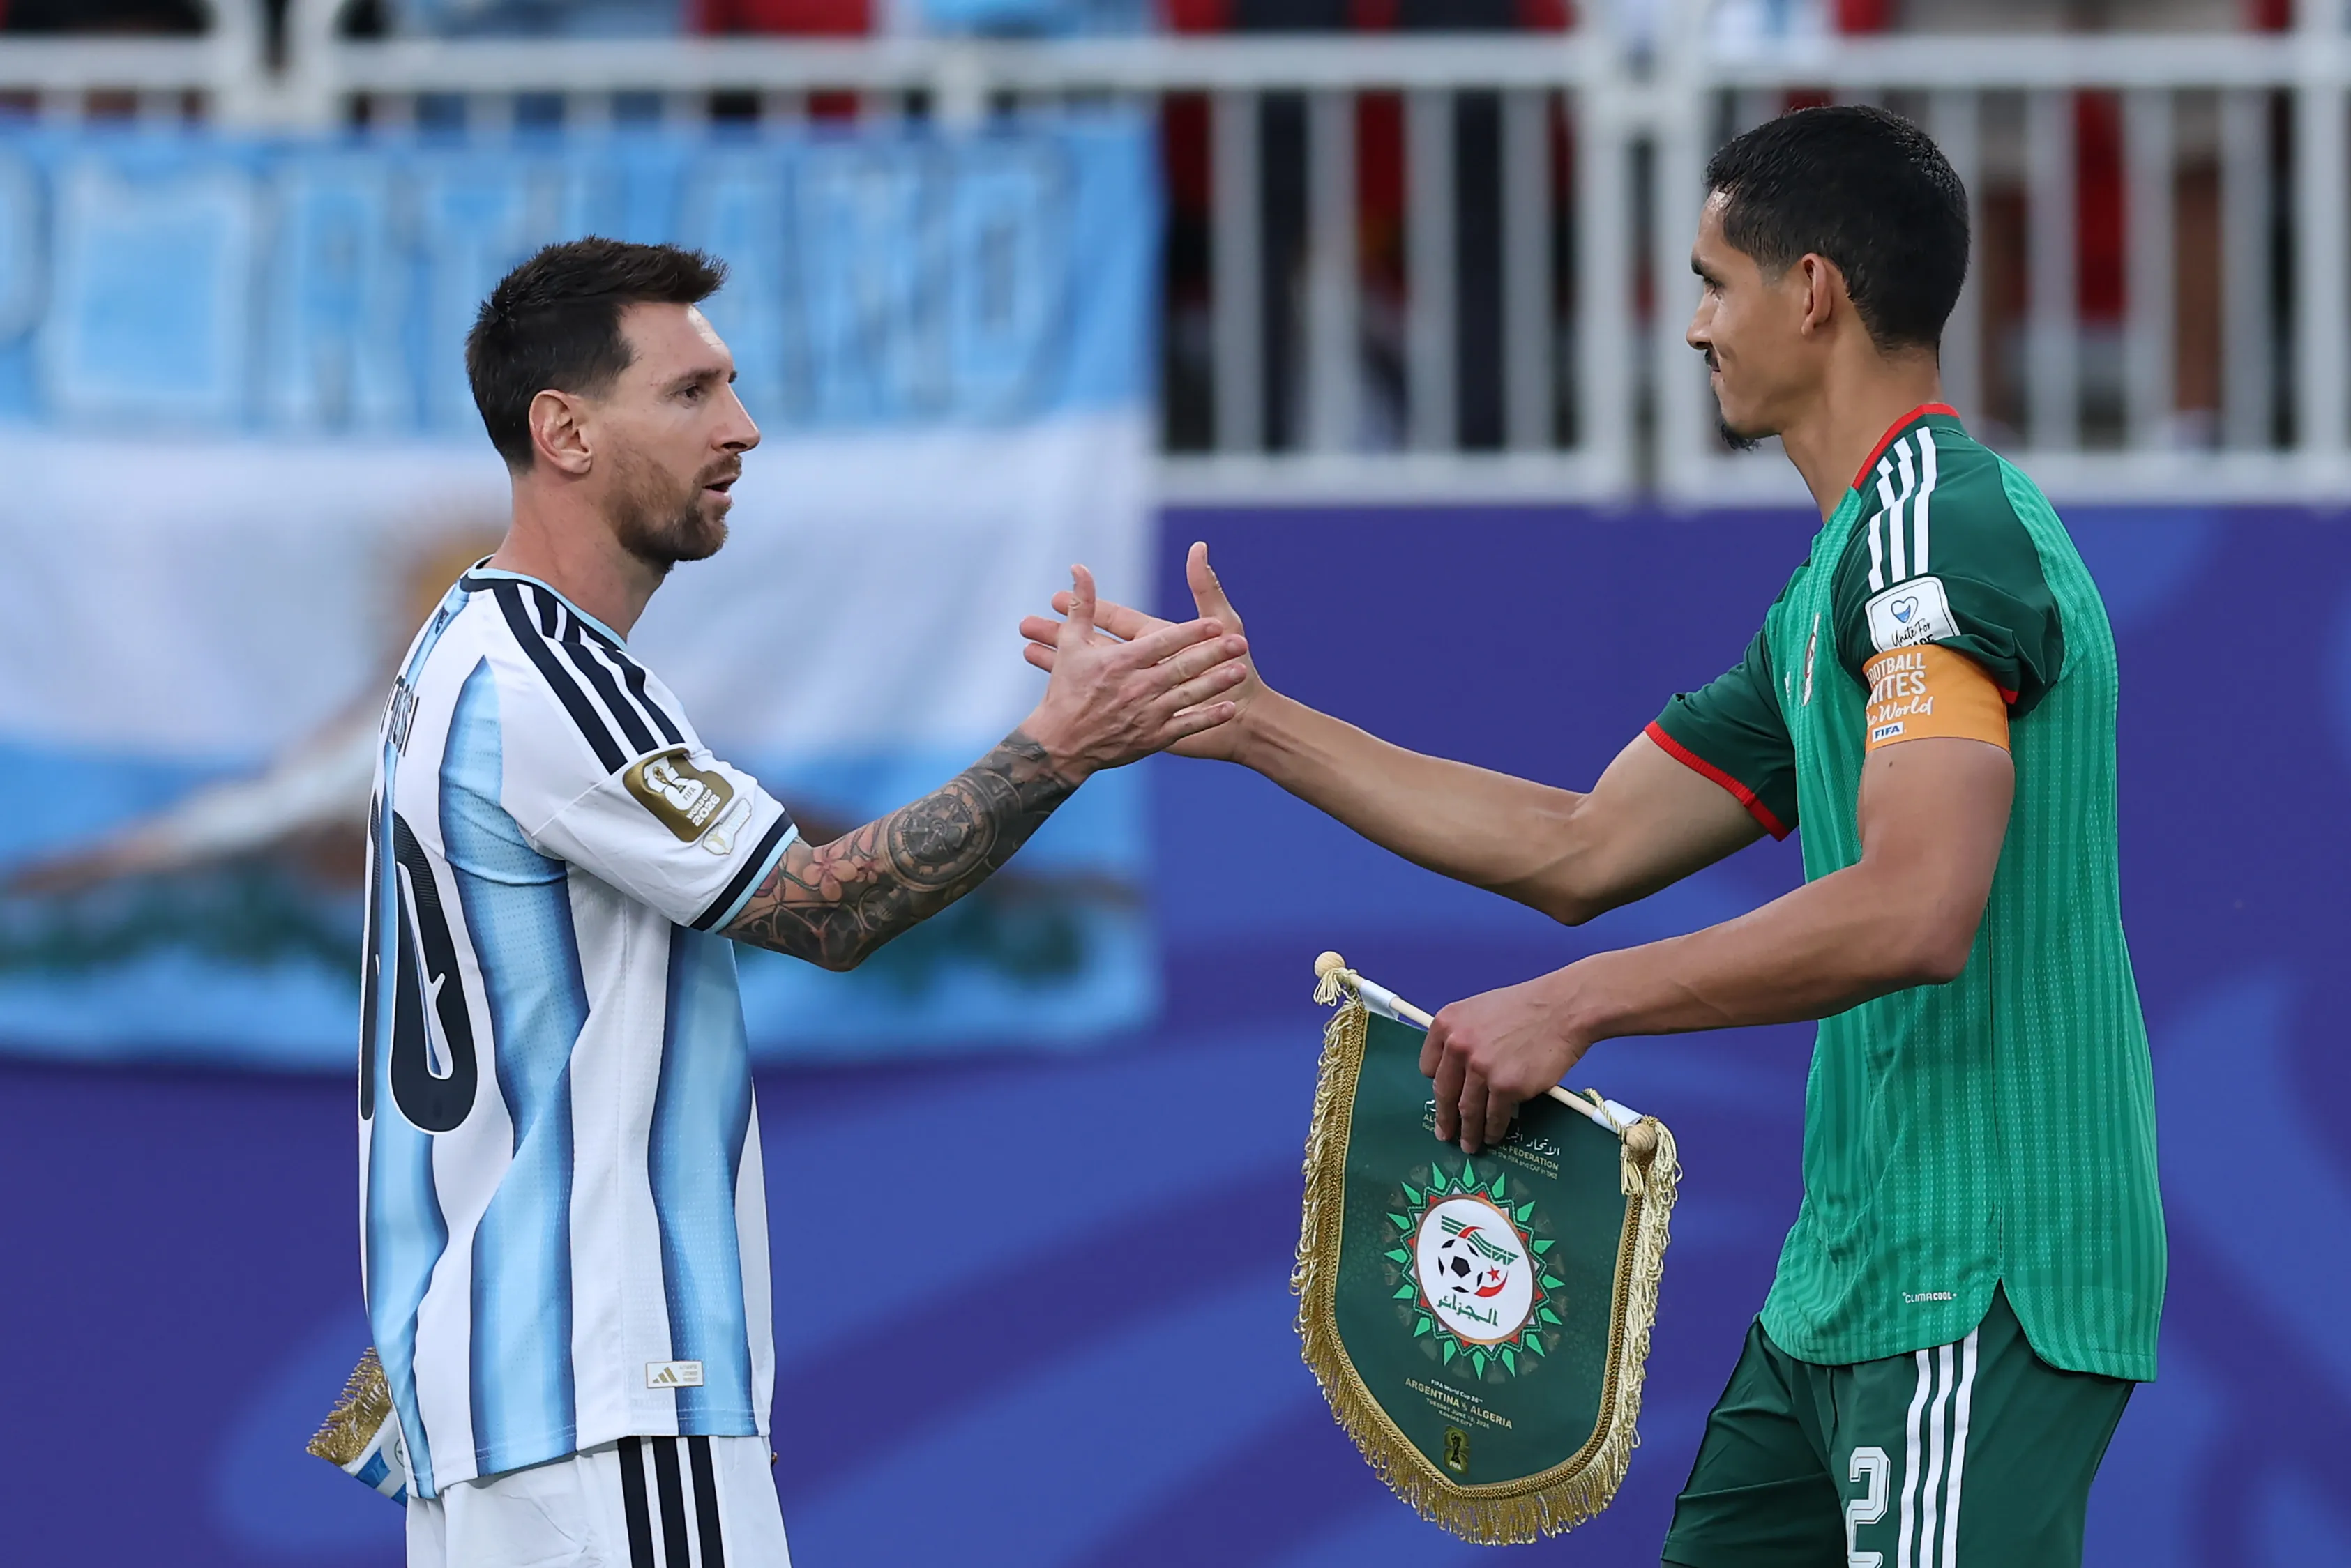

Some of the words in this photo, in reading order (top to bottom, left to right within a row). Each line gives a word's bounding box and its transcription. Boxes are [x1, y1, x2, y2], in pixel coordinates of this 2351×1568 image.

[1915, 618, 1930, 636] For
[1879, 696, 1935, 722] World
[1875, 725, 1900, 739] FIFA
[683, 787, 697, 801] FIFA
[686, 799, 705, 819] WORLD
[702, 789, 712, 800] CUP
[692, 794, 720, 827] 2026
[1509, 1145, 1559, 1171] FEDERATION
[1437, 1293, 1498, 1327] الجزائر
[1430, 1379, 1444, 1389] FIFA
[1444, 1384, 1460, 1395] World
[1460, 1391, 1471, 1400] Cup
[1405, 1378, 1460, 1408] ARGENTINA
[1470, 1405, 1513, 1429] ALGERIA
[1845, 1447, 1891, 1568] 2
